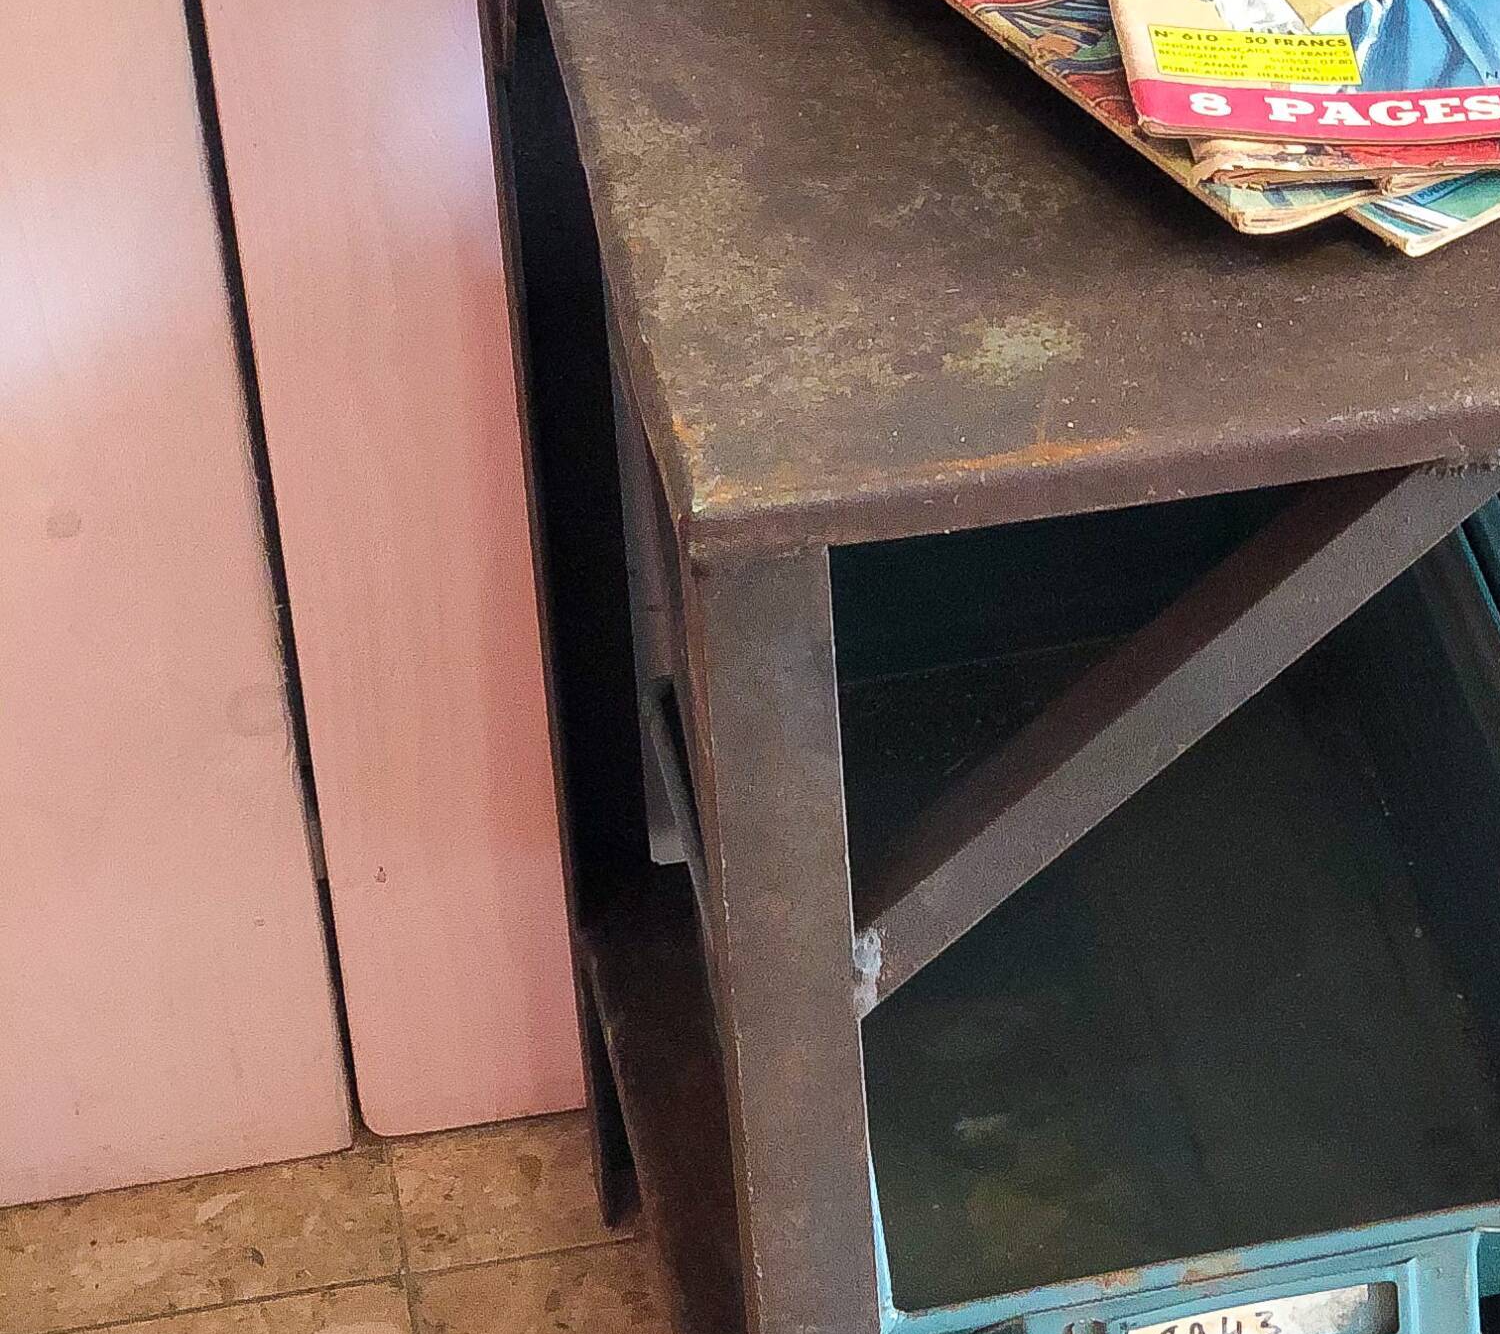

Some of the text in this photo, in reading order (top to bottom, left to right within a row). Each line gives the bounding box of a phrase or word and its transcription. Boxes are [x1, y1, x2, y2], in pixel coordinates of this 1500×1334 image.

[1182, 33, 1218, 42] 610
[1274, 38, 1348, 48] FRANCS
[1188, 92, 1232, 118] 8
